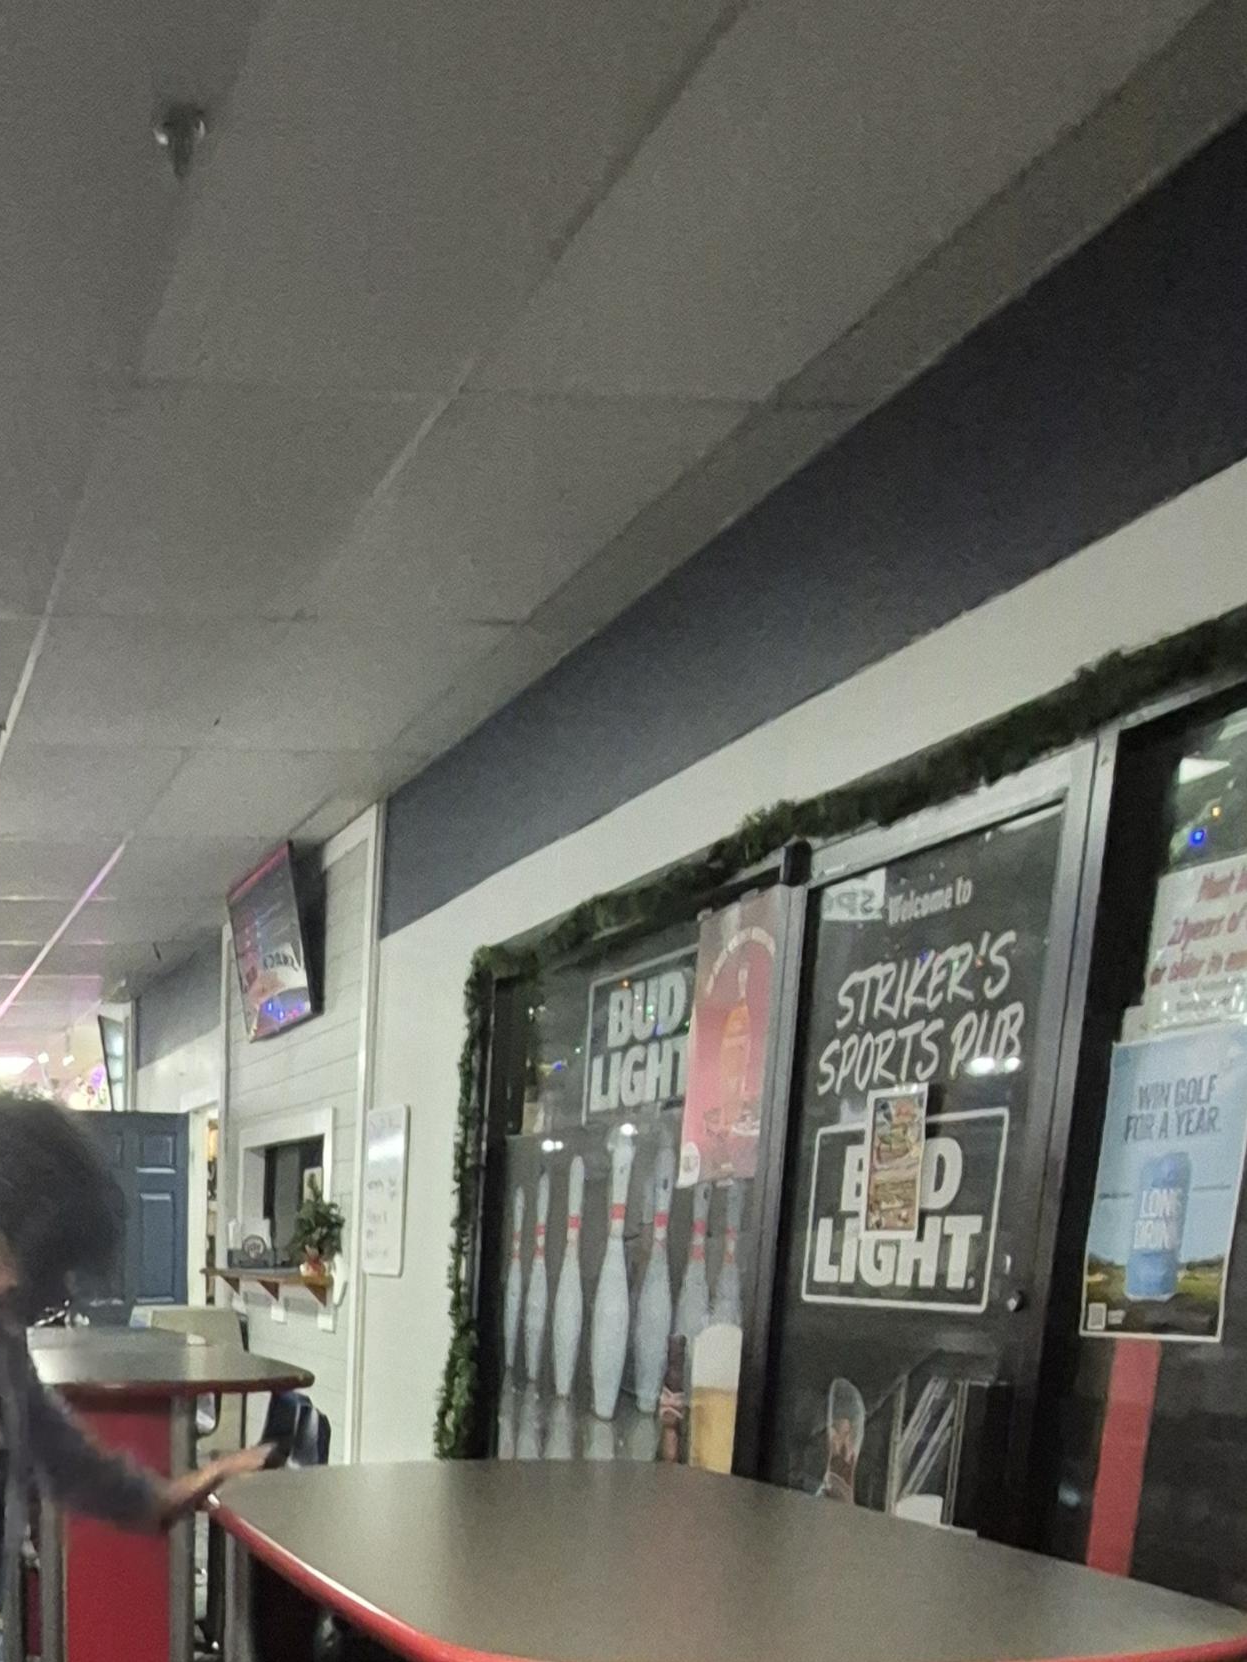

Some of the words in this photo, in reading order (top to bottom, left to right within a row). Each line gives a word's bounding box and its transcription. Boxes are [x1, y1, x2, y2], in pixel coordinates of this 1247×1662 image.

[889, 889, 953, 925] Welcome
[955, 876, 972, 906] to
[607, 971, 687, 1048] BUD
[836, 929, 1017, 1029] STRIKER'S
[817, 1018, 944, 1096] SPORTS
[951, 1001, 1024, 1080] PUB
[1158, 1110, 1169, 1139] A
[1174, 1073, 1217, 1107] GOLF
[841, 1137, 963, 1211] BD
[813, 1214, 983, 1288] LIGHT
